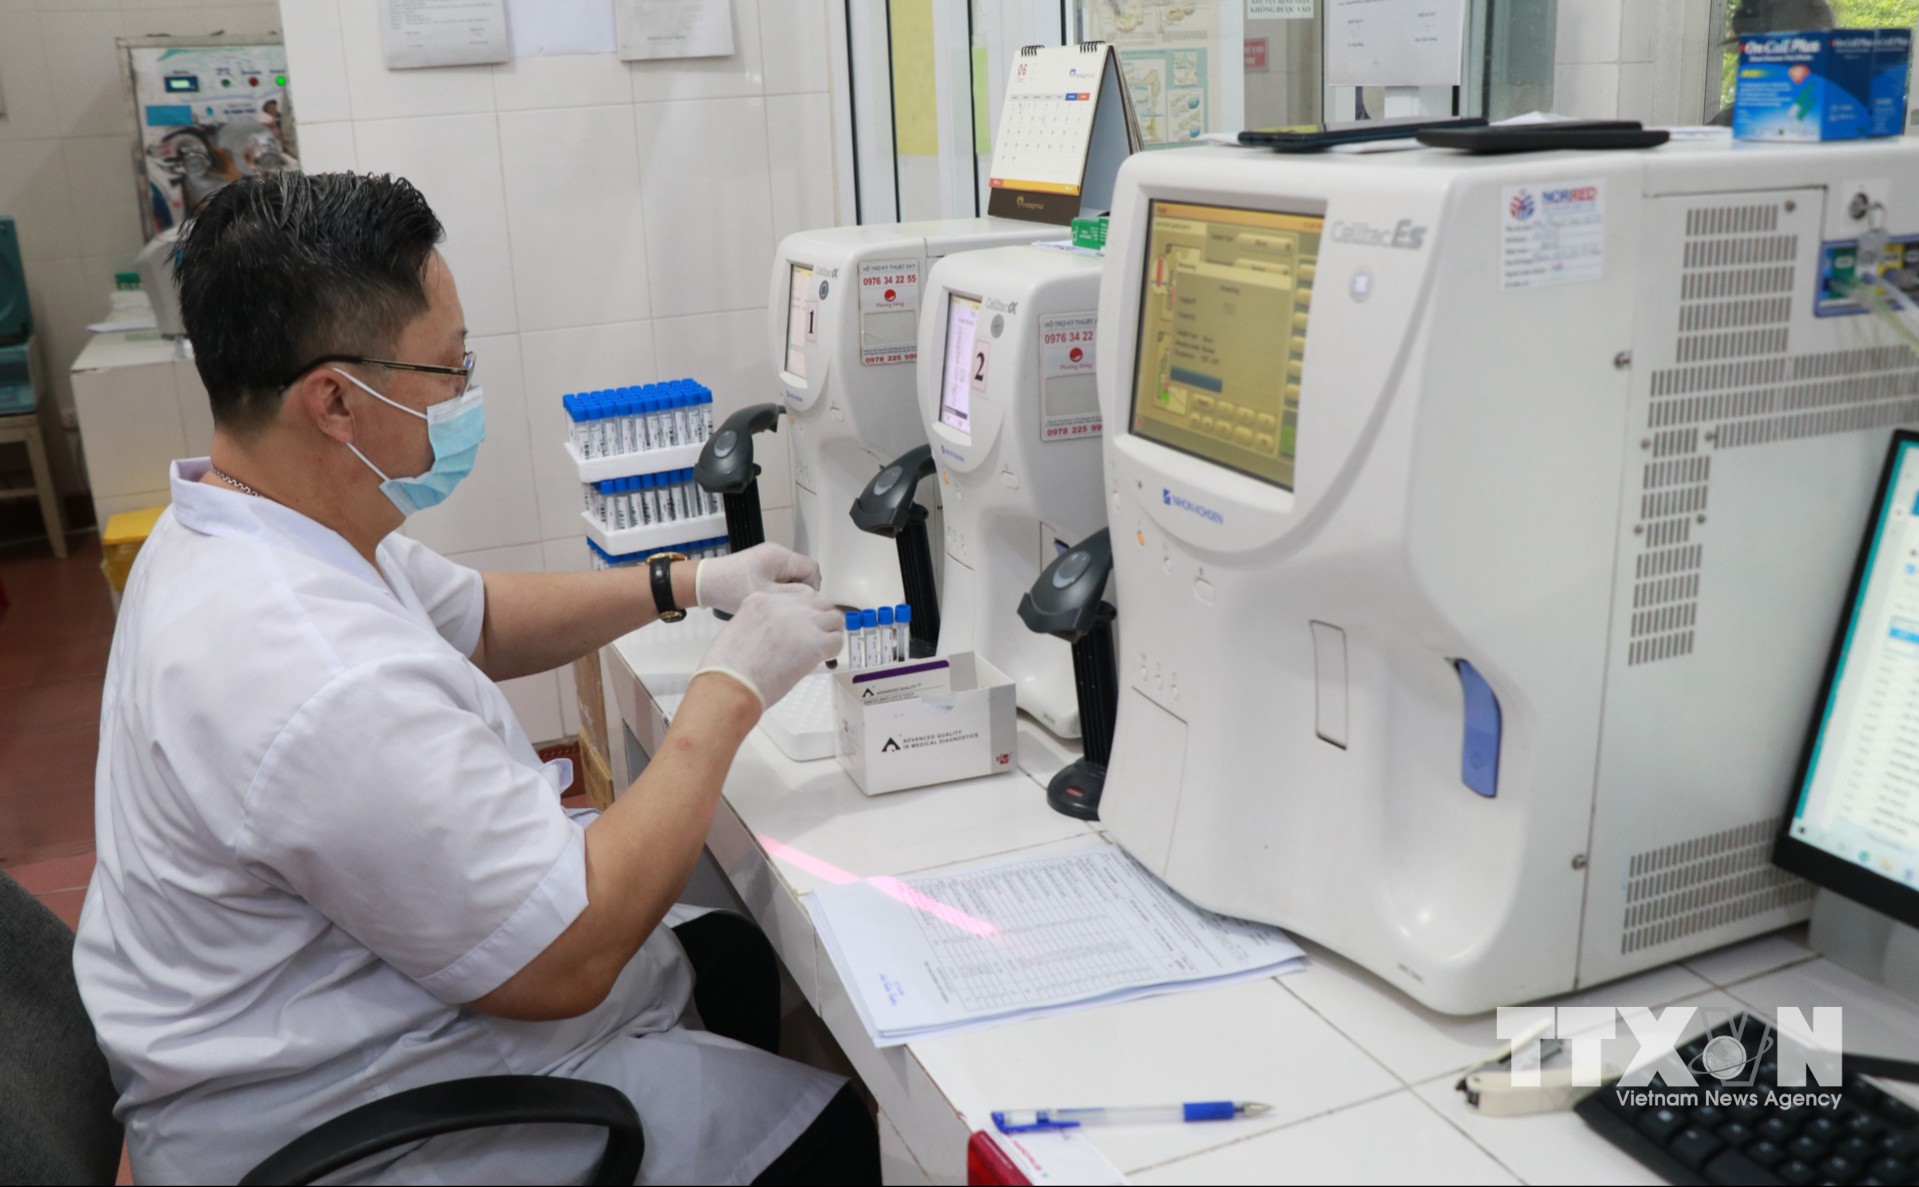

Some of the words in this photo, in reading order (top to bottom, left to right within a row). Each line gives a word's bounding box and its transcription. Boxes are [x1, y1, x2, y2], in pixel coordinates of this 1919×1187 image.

[863, 276, 882, 286] 0976
[883, 275, 893, 285] 34
[895, 274, 905, 284] 22
[907, 273, 917, 283] 55
[809, 310, 814, 334] 1
[1045, 332, 1067, 345] 0976
[1069, 331, 1080, 342] 34
[1082, 330, 1094, 341] 22
[865, 355, 885, 364] 0978
[974, 352, 985, 381] 2
[1047, 427, 1069, 437] 0978
[1071, 425, 1088, 434] 225
[903, 734, 936, 743] ADVANCED
[936, 729, 962, 739] QUALITY
[911, 739, 938, 749] MEDICAL
[939, 732, 979, 744] DIAGNOSTICS
